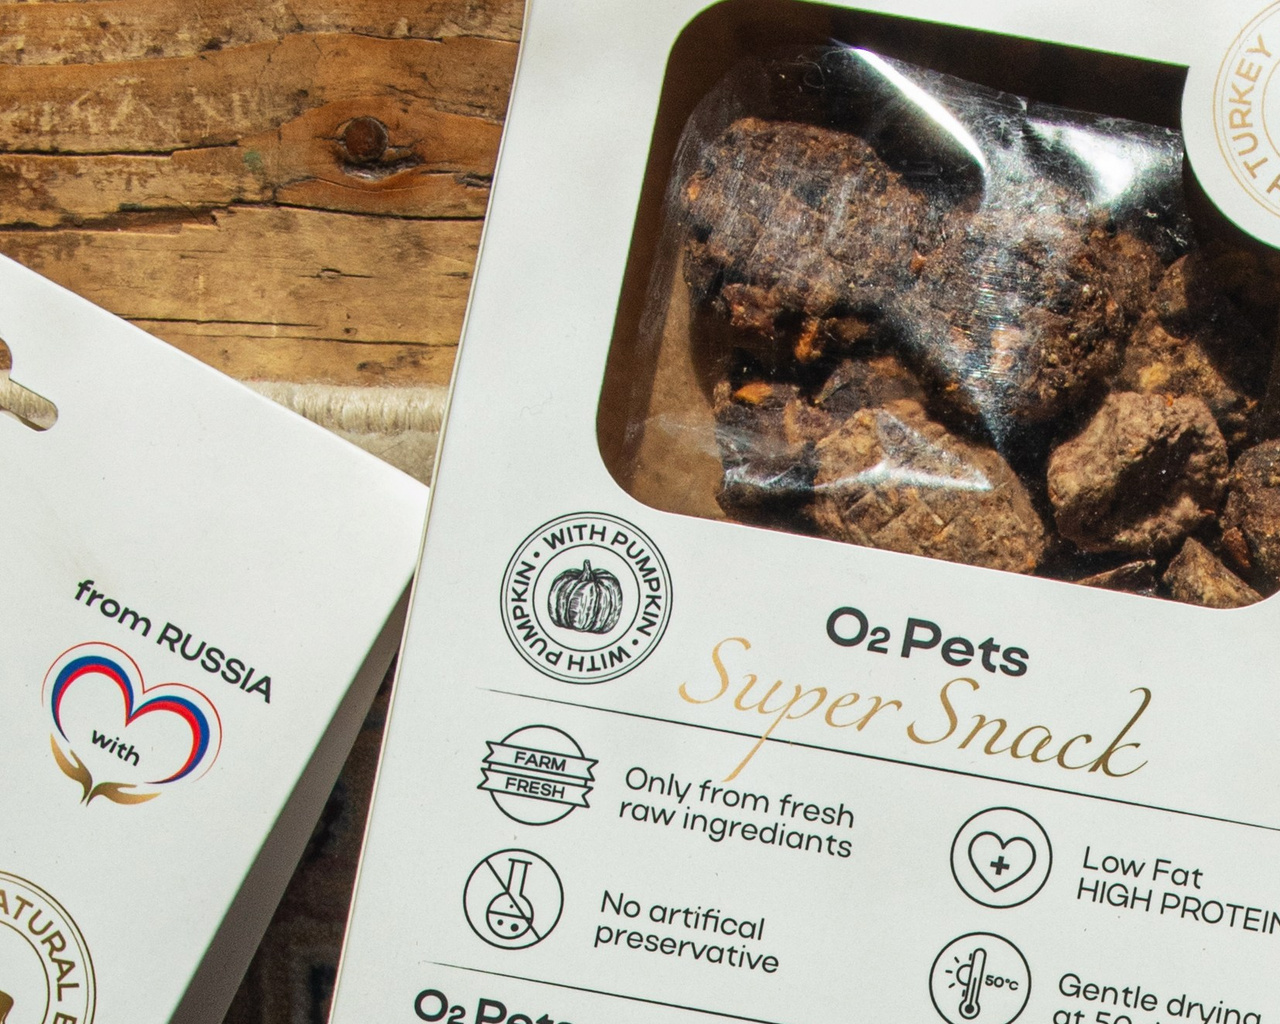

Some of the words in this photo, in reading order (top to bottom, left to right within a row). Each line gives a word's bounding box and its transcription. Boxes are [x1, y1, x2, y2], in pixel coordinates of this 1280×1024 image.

[1228, 34, 1272, 179] TURKEY
[542, 524, 607, 550] WITH
[610, 531, 662, 637] PUMPKIN
[511, 560, 563, 667] PUMPKIN
[74, 579, 152, 637] from
[156, 623, 273, 704] RUSSIA
[567, 645, 633, 673] WITH
[900, 617, 1030, 678] Pets
[678, 637, 903, 783] Super
[906, 677, 1152, 778] Snack
[90, 727, 141, 767] with
[514, 751, 567, 772] FARM
[504, 777, 566, 799] FRESH
[625, 766, 692, 804] Only
[698, 779, 770, 814] from
[778, 793, 856, 829] fresh
[619, 798, 676, 827] raw
[682, 805, 853, 859] ingrediants
[1076, 876, 1153, 912] HIGH
[1082, 845, 1146, 878] Low
[1152, 859, 1204, 890] Fat
[599, 889, 641, 920] No
[648, 903, 766, 942] artifical
[593, 921, 780, 974] preservative
[1058, 972, 1158, 1011] Gentle
